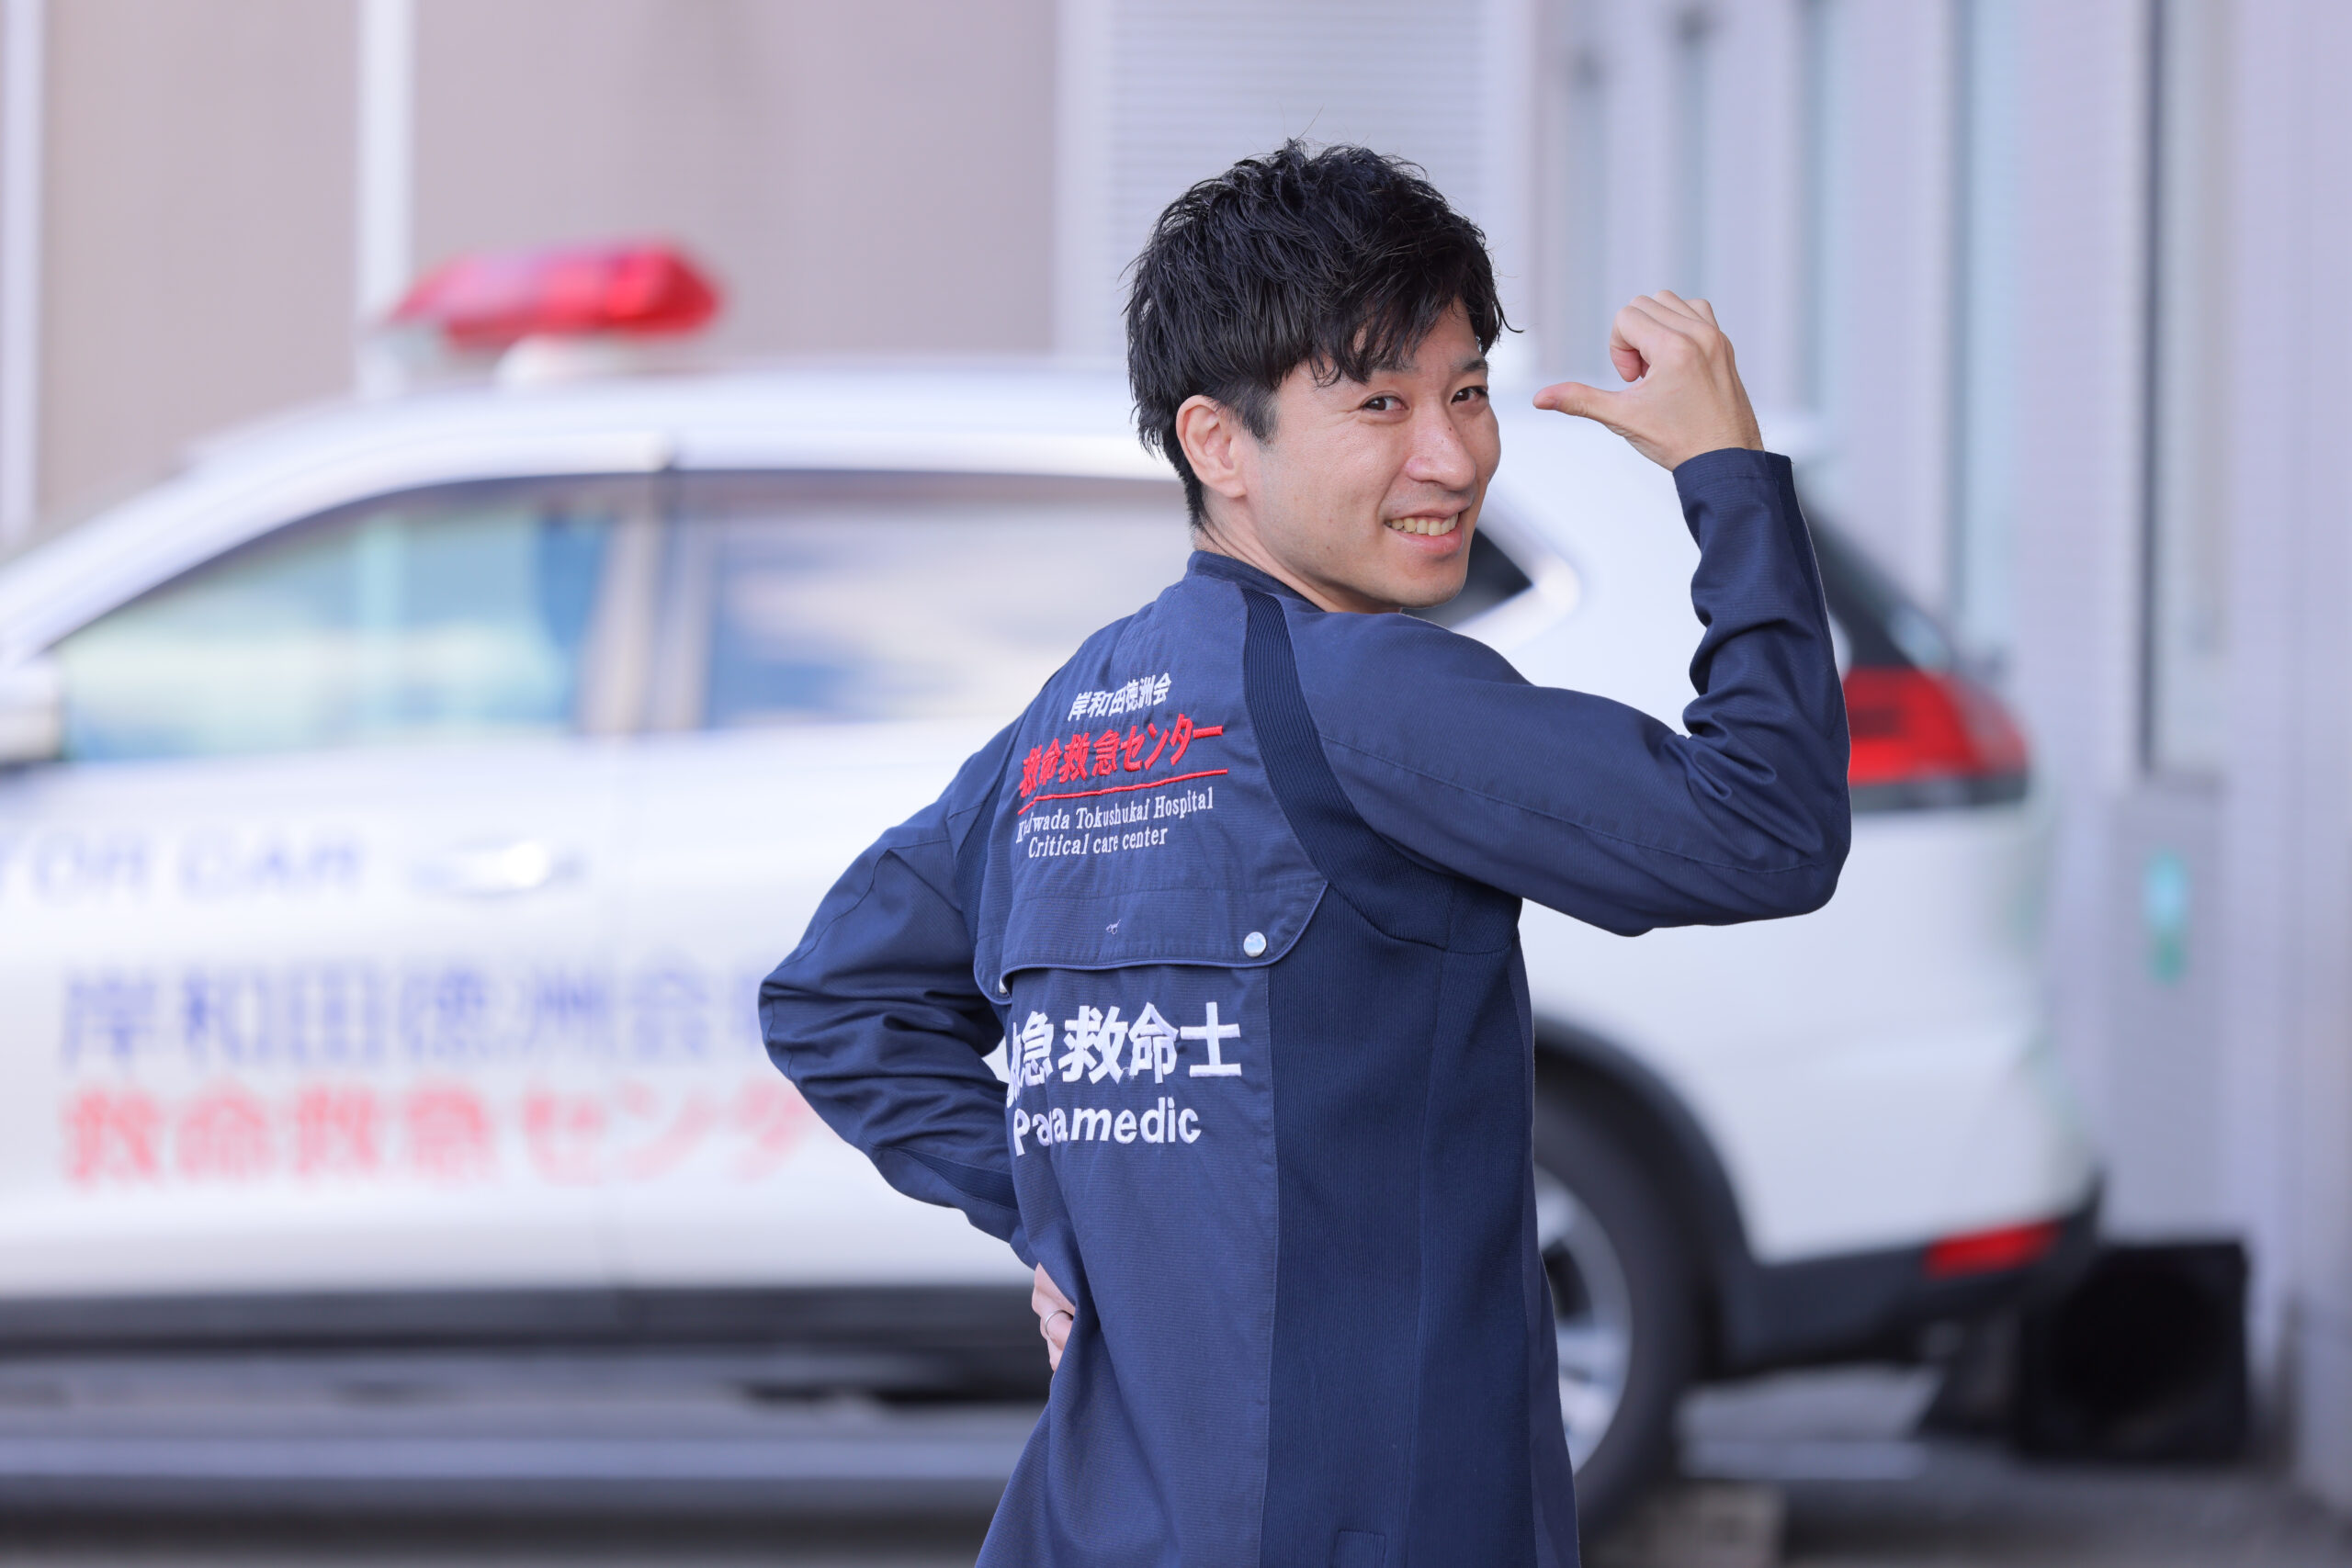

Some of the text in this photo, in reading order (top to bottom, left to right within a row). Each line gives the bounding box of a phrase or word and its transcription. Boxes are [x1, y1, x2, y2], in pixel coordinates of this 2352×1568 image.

[1068, 672, 1171, 721] 岸和田徳洲会
[1019, 713, 1224, 798] 救命救急センター
[1075, 798, 1149, 829] Tokushukai
[1153, 786, 1214, 818] Hospital
[1028, 826, 1169, 859] Critical care center
[1012, 1096, 1202, 1156] Paamedic
